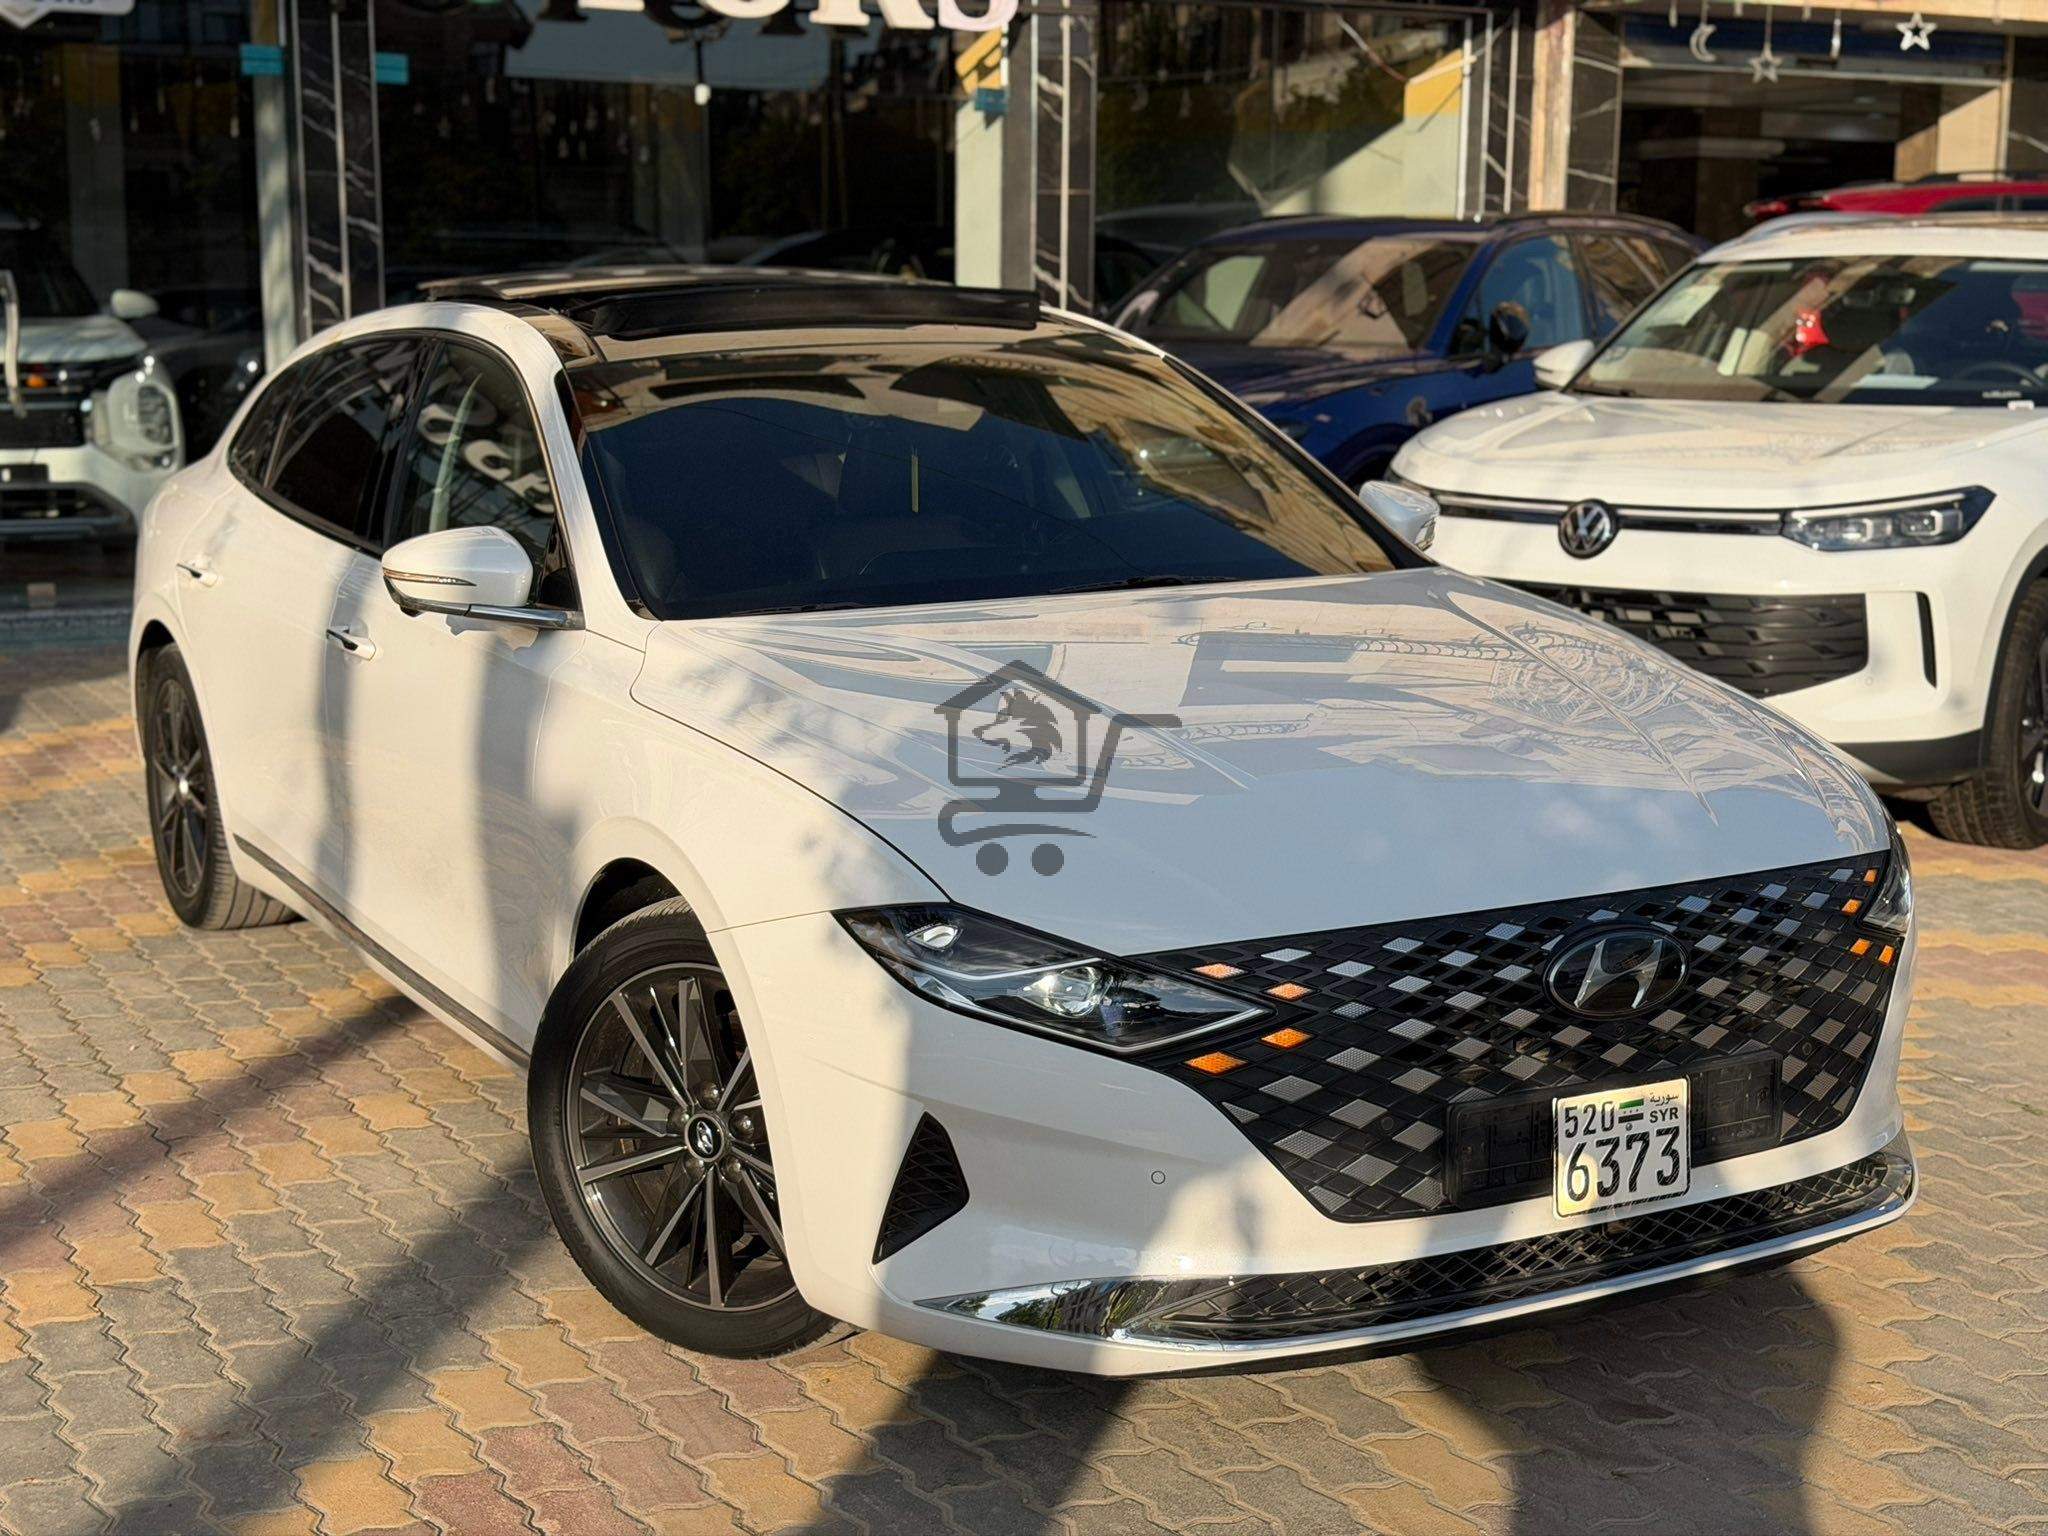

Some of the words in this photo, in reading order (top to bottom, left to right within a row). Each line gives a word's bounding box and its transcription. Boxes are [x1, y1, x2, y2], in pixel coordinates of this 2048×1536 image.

[1564, 1101, 1615, 1138] 520
[1649, 1107, 1680, 1124] SYR
[1566, 1125, 1681, 1202] 6373
